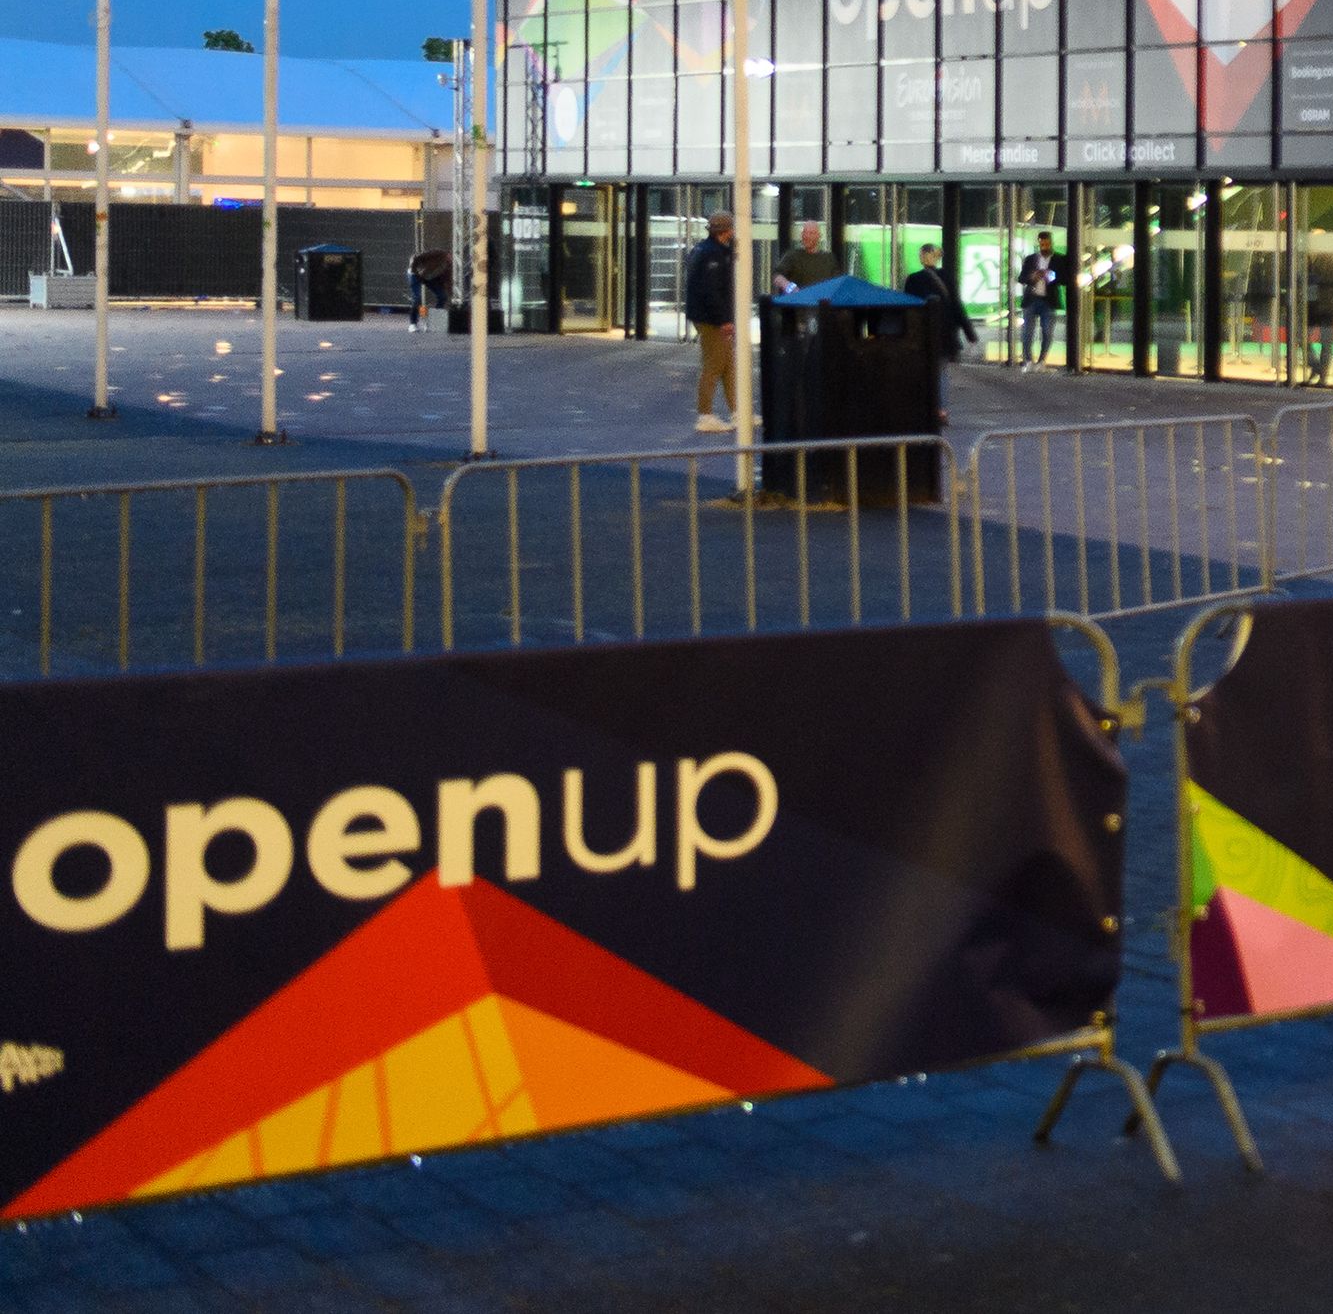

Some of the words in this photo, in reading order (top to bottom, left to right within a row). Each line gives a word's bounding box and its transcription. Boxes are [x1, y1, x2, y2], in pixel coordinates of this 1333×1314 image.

[1084, 142, 1116, 162] Click
[1131, 141, 1176, 162] collect
[12, 750, 779, 952] openup
